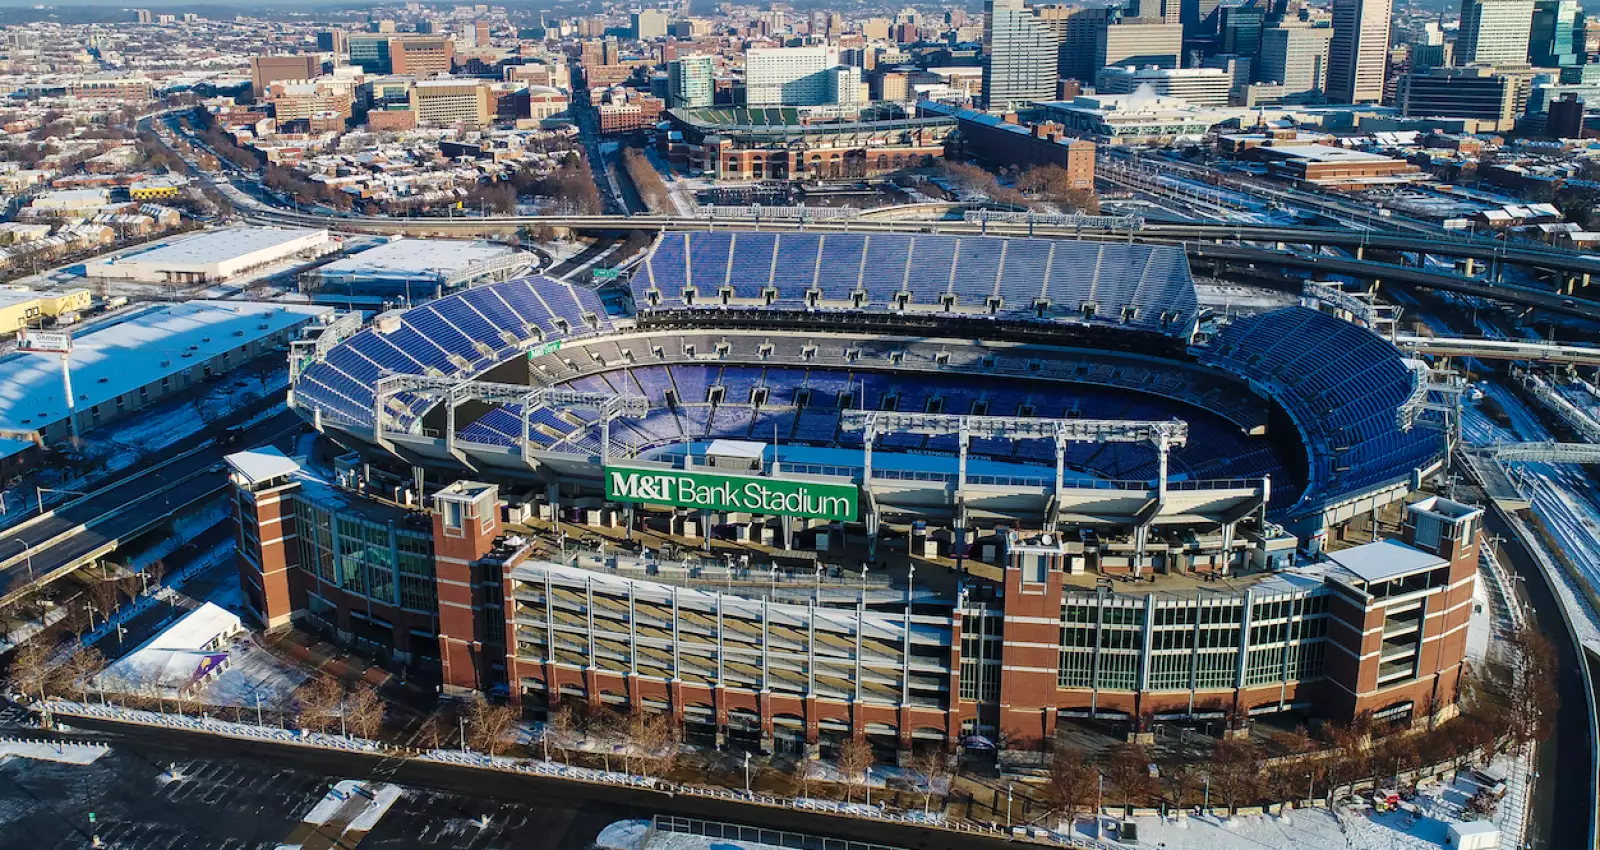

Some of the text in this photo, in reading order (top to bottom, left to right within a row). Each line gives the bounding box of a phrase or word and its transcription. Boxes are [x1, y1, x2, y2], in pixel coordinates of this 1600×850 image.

[611, 471, 850, 517] M&T Bank Stadium
